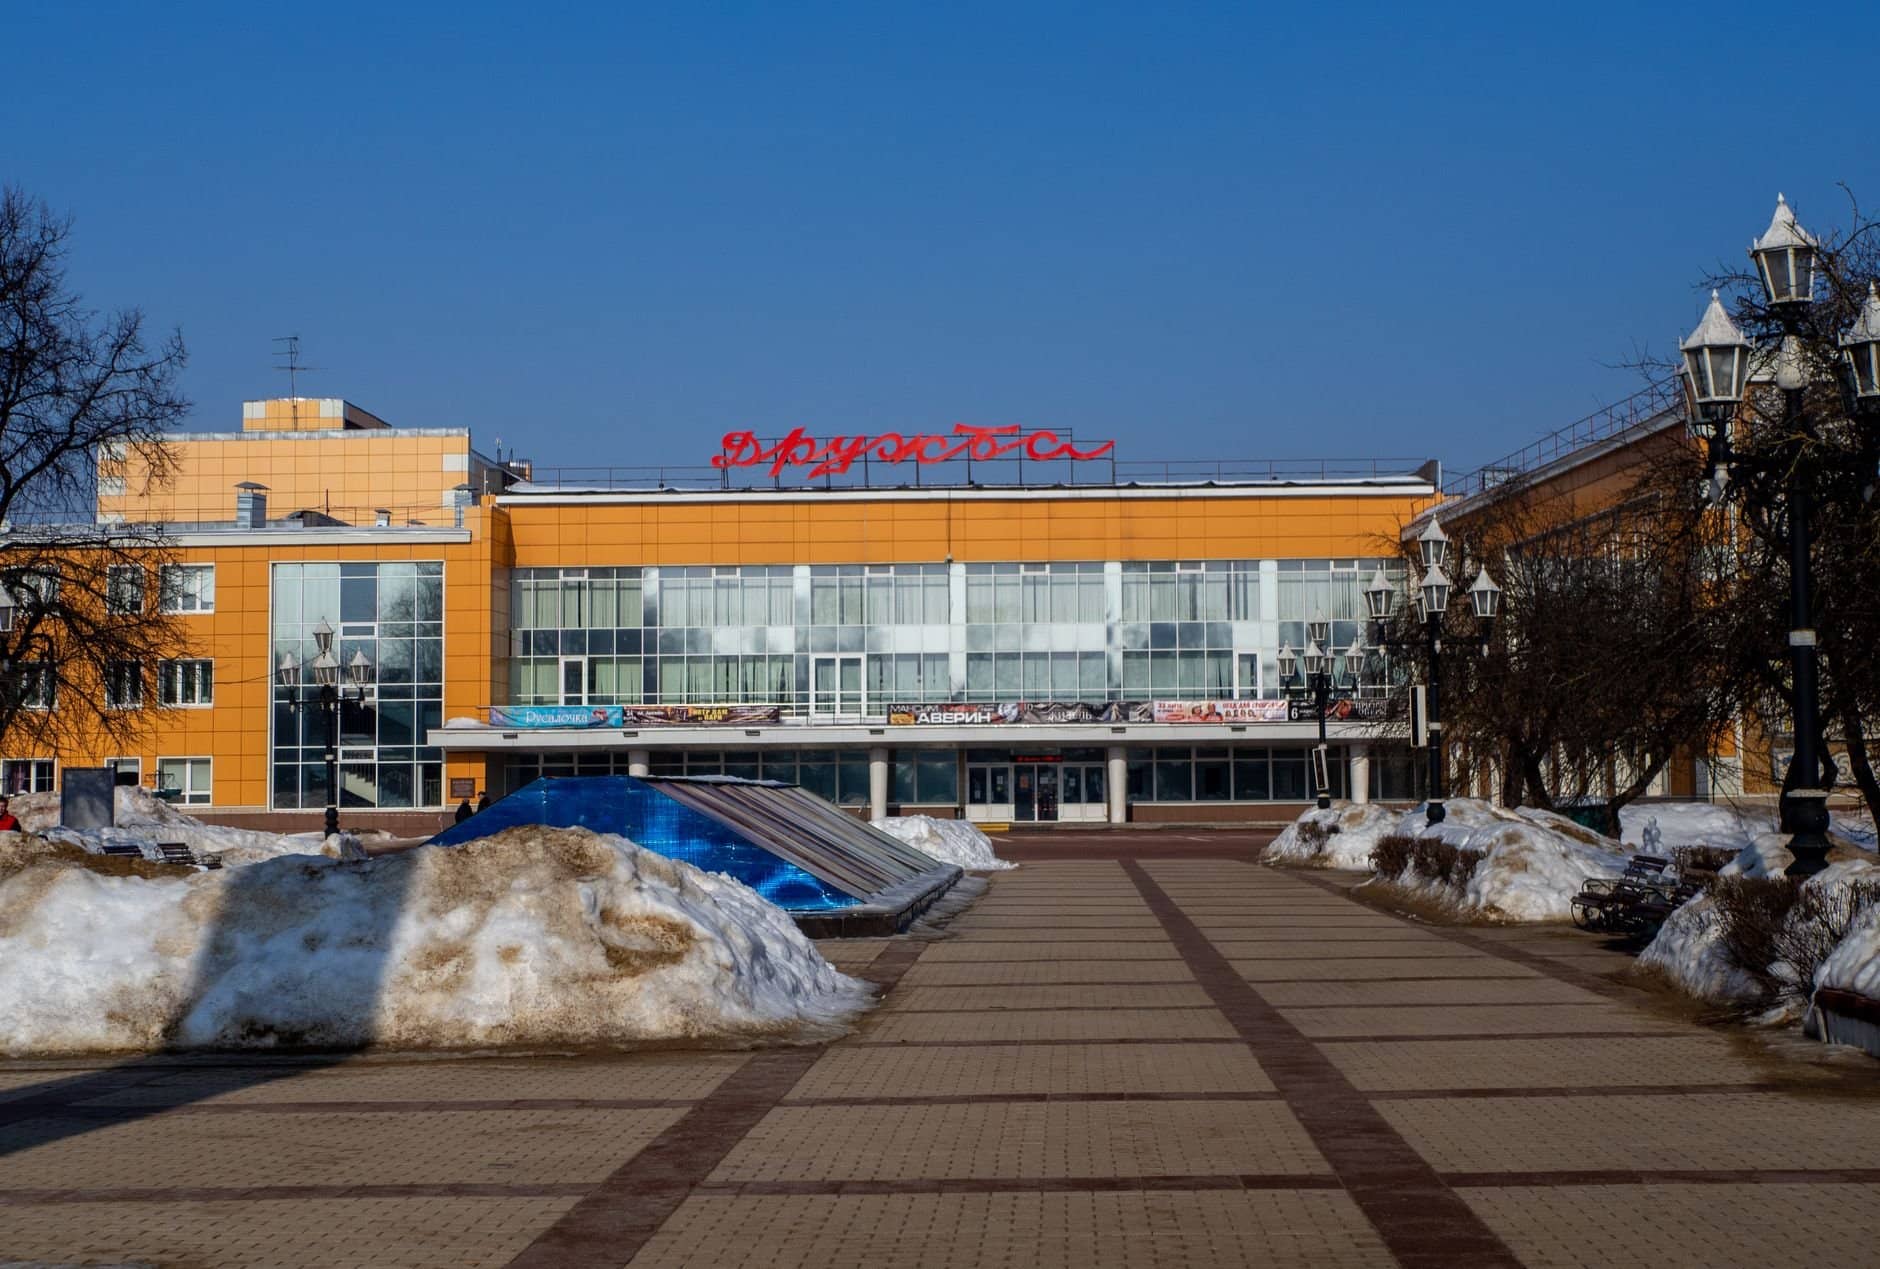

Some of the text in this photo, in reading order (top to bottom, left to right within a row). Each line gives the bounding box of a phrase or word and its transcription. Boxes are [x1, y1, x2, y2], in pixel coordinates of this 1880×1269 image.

[526, 711, 588, 725] Русалочка
[916, 712, 991, 723] АВЕРИН
[1291, 707, 1298, 719] 6
